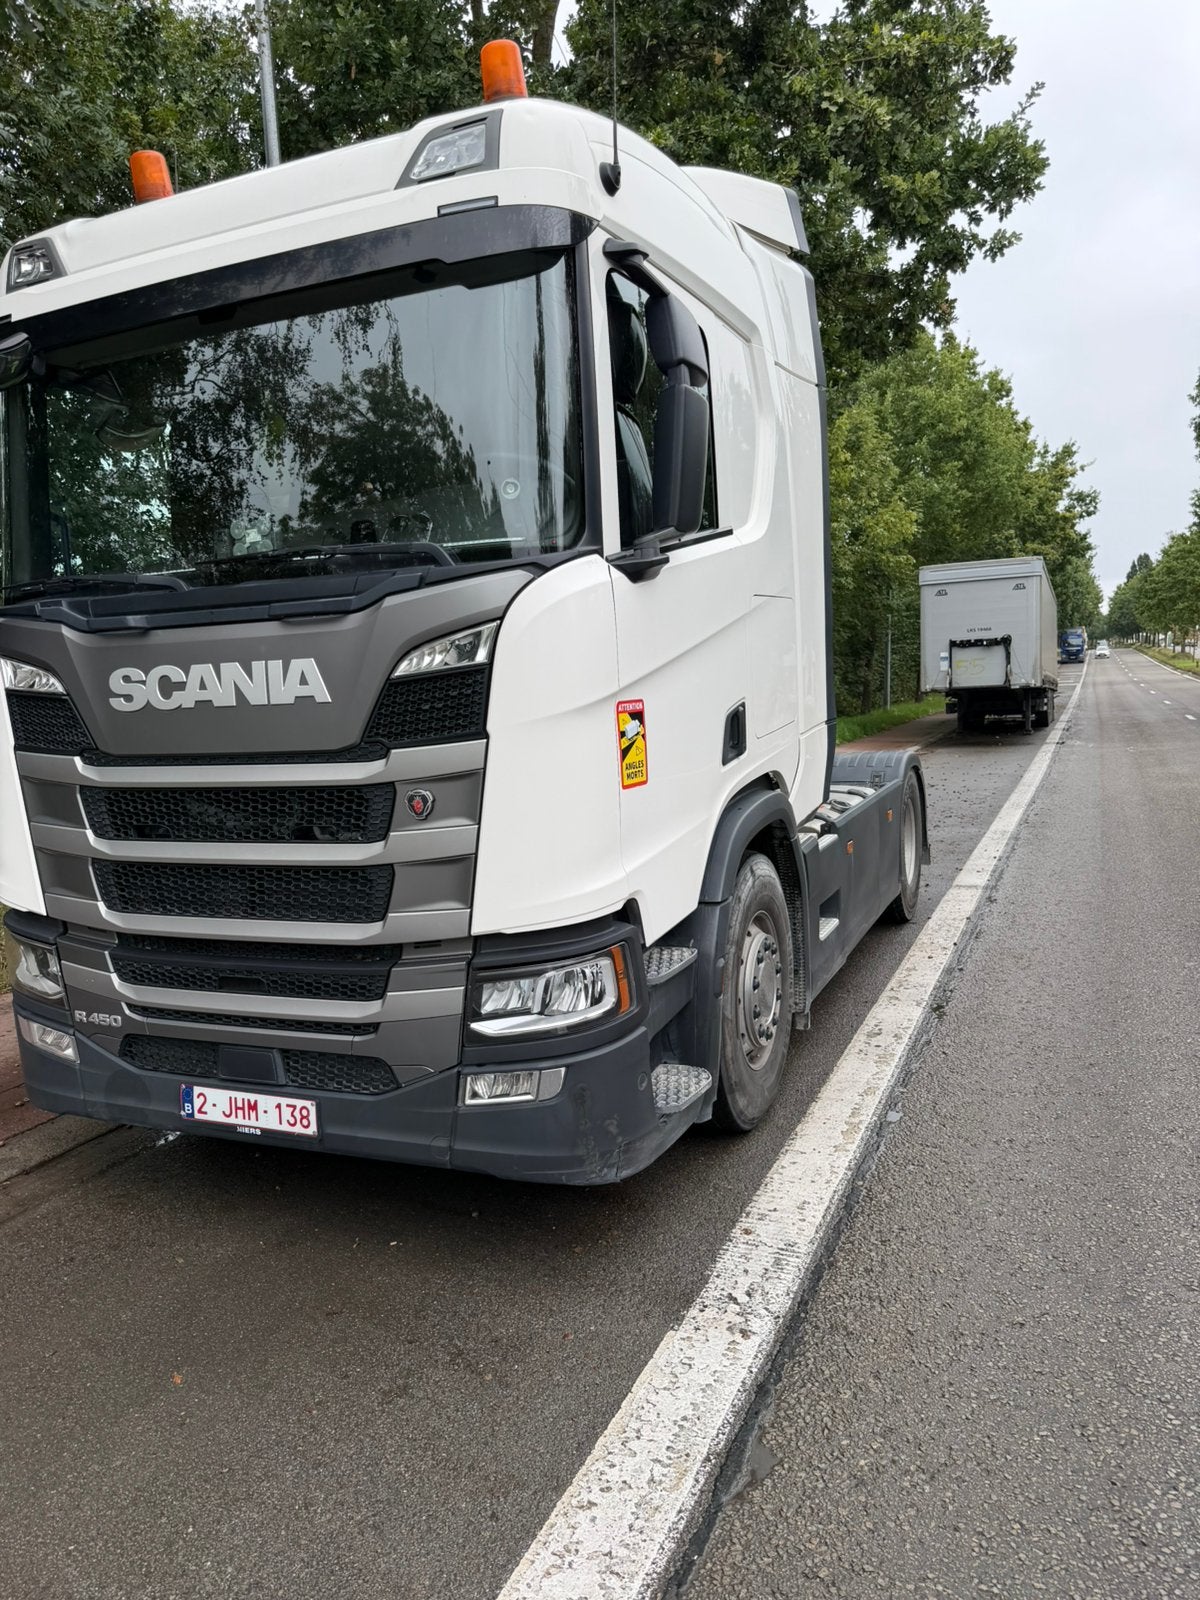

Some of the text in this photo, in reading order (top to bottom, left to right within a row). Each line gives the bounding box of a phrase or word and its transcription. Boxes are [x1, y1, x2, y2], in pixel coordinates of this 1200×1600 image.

[108, 657, 332, 712] SCANIA
[618, 701, 643, 712] ATTENTION
[625, 760, 644, 771] ANGLES
[626, 769, 644, 780] MORTS
[74, 1009, 122, 1028] R 450
[184, 1102, 193, 1114] B
